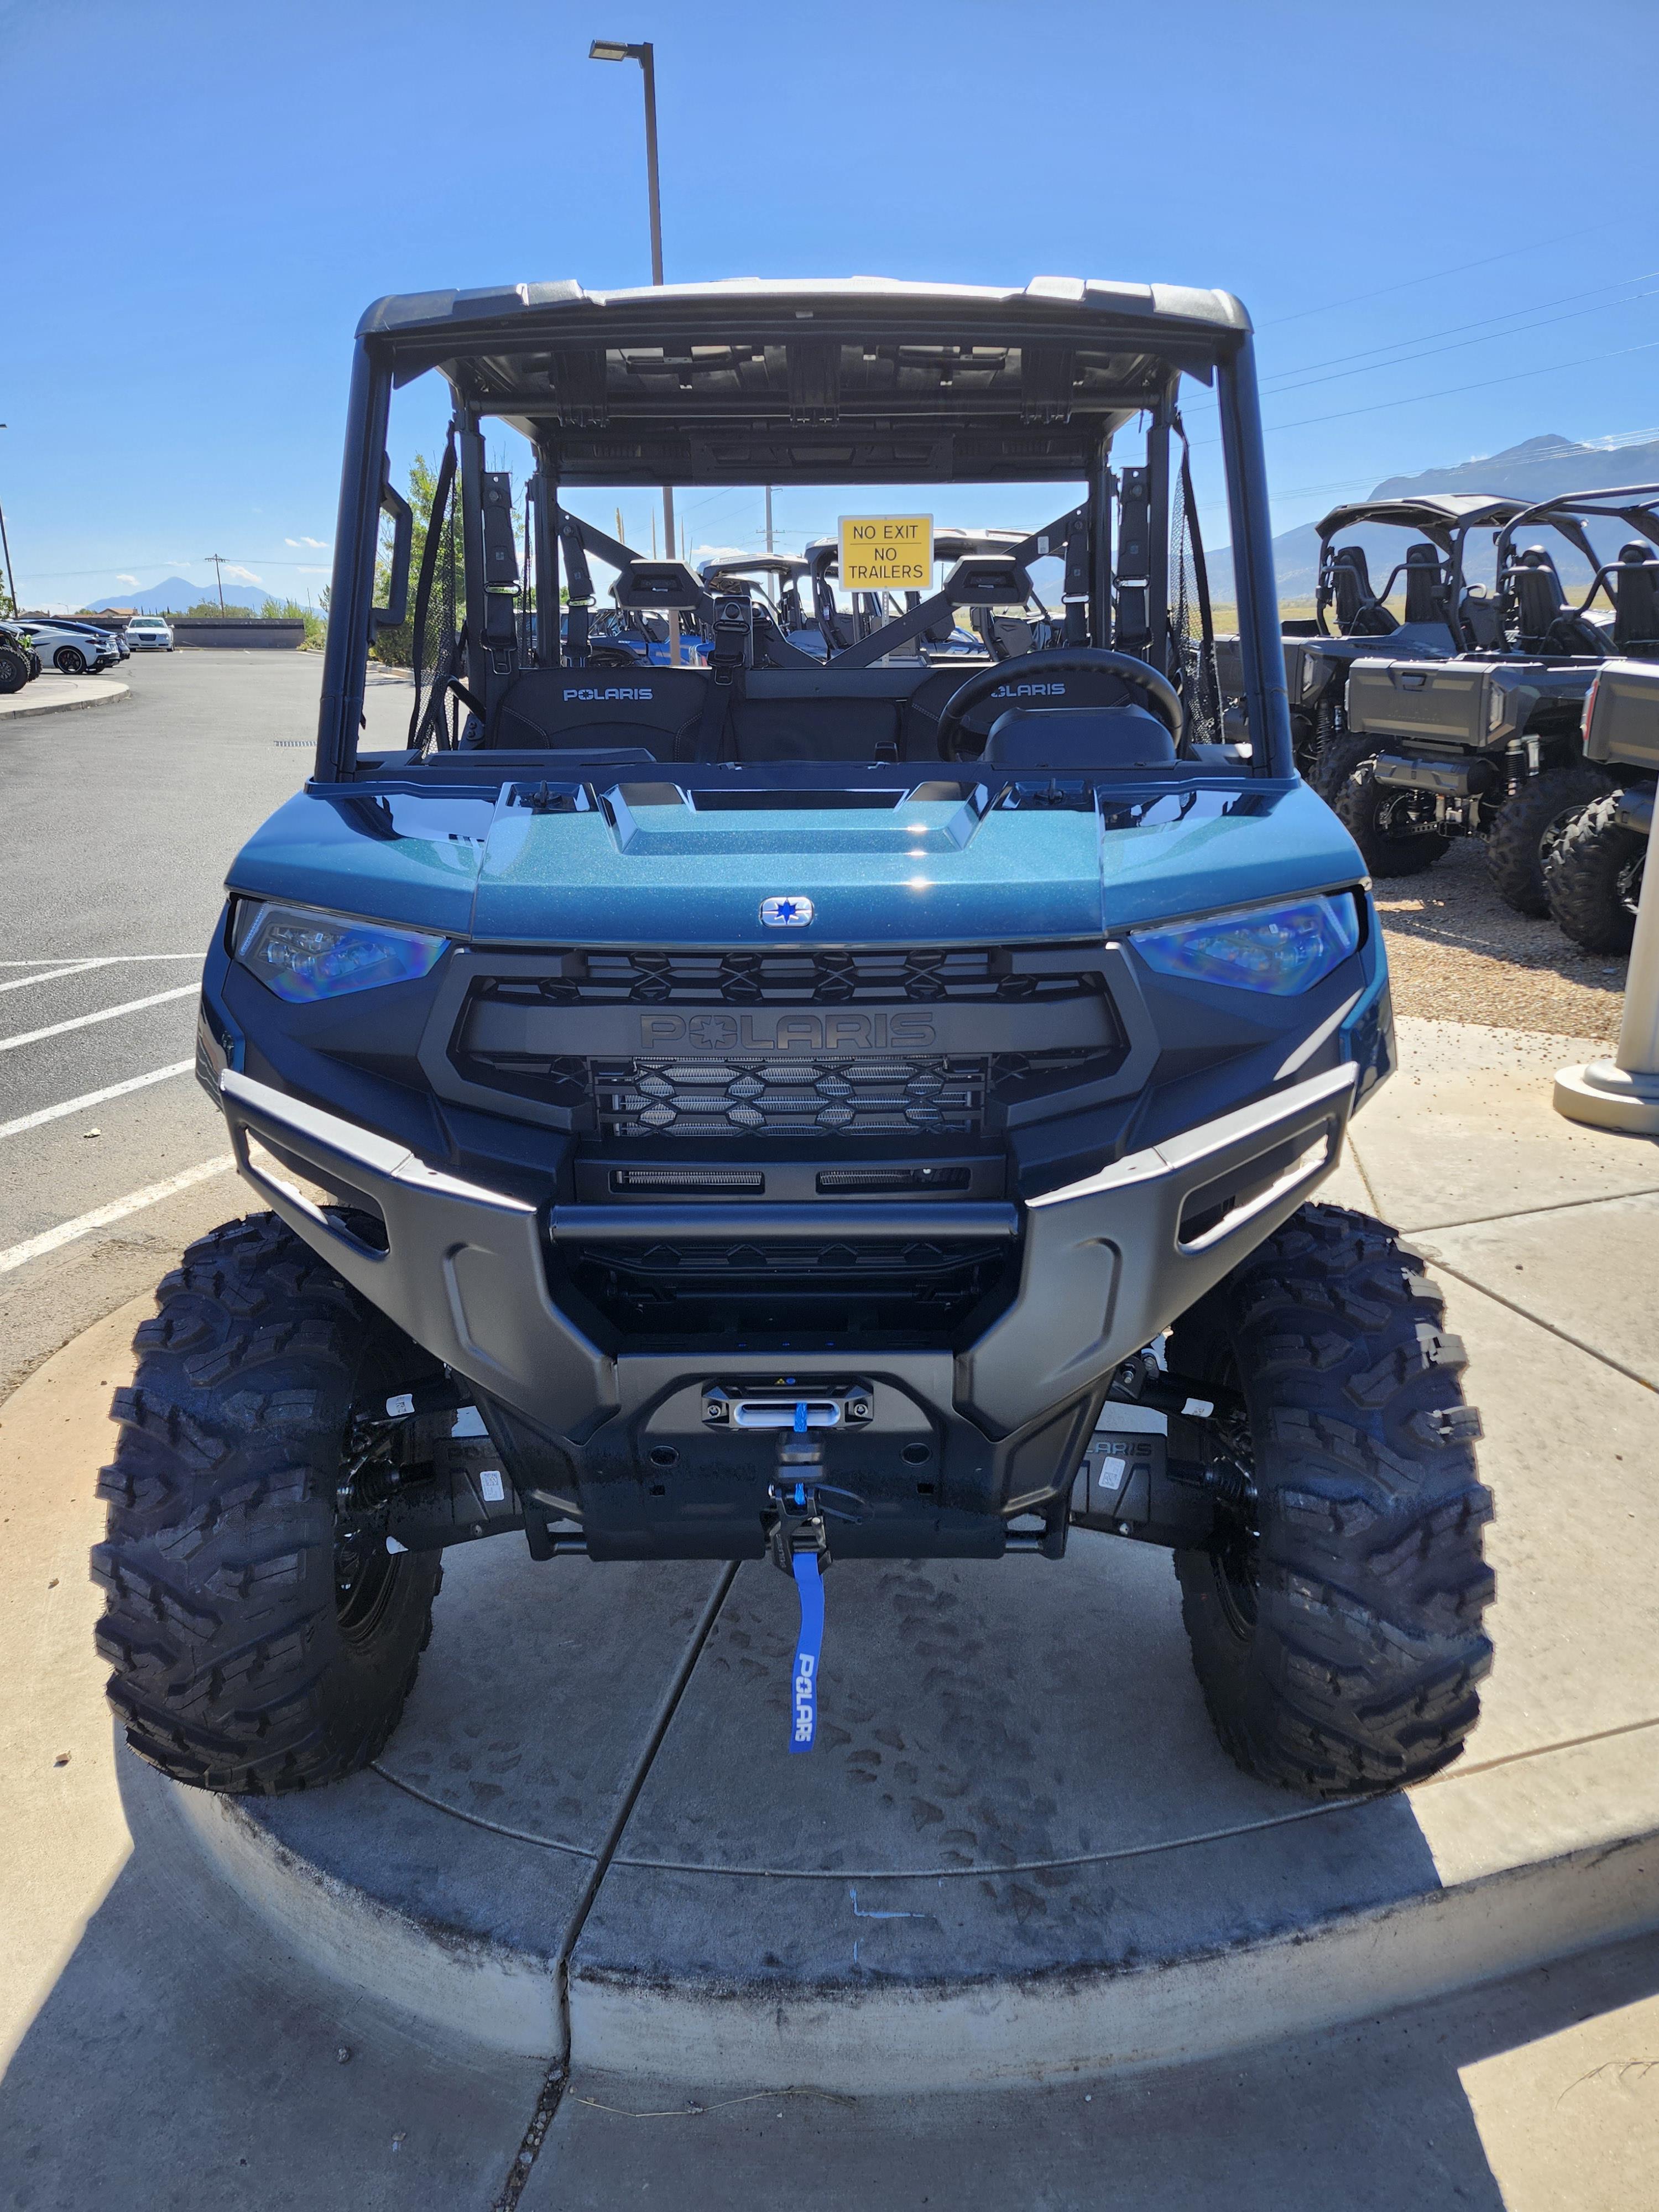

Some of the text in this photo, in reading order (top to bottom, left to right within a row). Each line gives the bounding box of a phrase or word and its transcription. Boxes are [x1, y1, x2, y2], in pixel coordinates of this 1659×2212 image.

[853, 525, 918, 540] NO EXIT
[874, 547, 897, 561] NO
[849, 565, 924, 579] TRAILERS
[563, 688, 653, 701] POLARIS
[990, 684, 1066, 697] OLARIS
[640, 1012, 936, 1050] POLARIS
